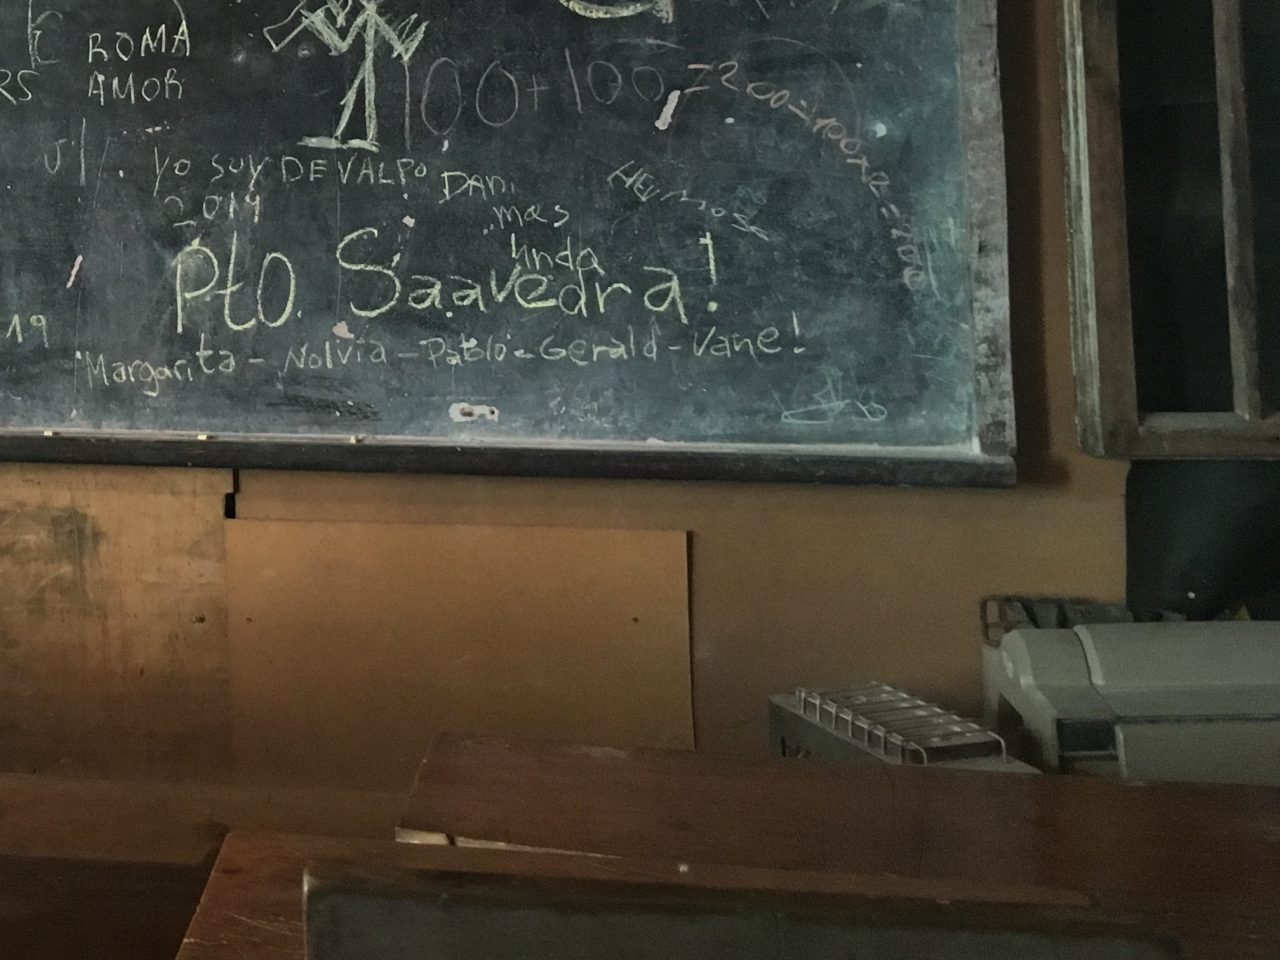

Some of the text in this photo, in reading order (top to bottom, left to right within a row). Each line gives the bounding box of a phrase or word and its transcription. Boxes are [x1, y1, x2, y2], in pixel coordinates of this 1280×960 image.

[88, 20, 191, 64] ROMA
[88, 68, 185, 107] AMOR
[281, 154, 328, 184] DE
[336, 227, 719, 325] Saavedra!
